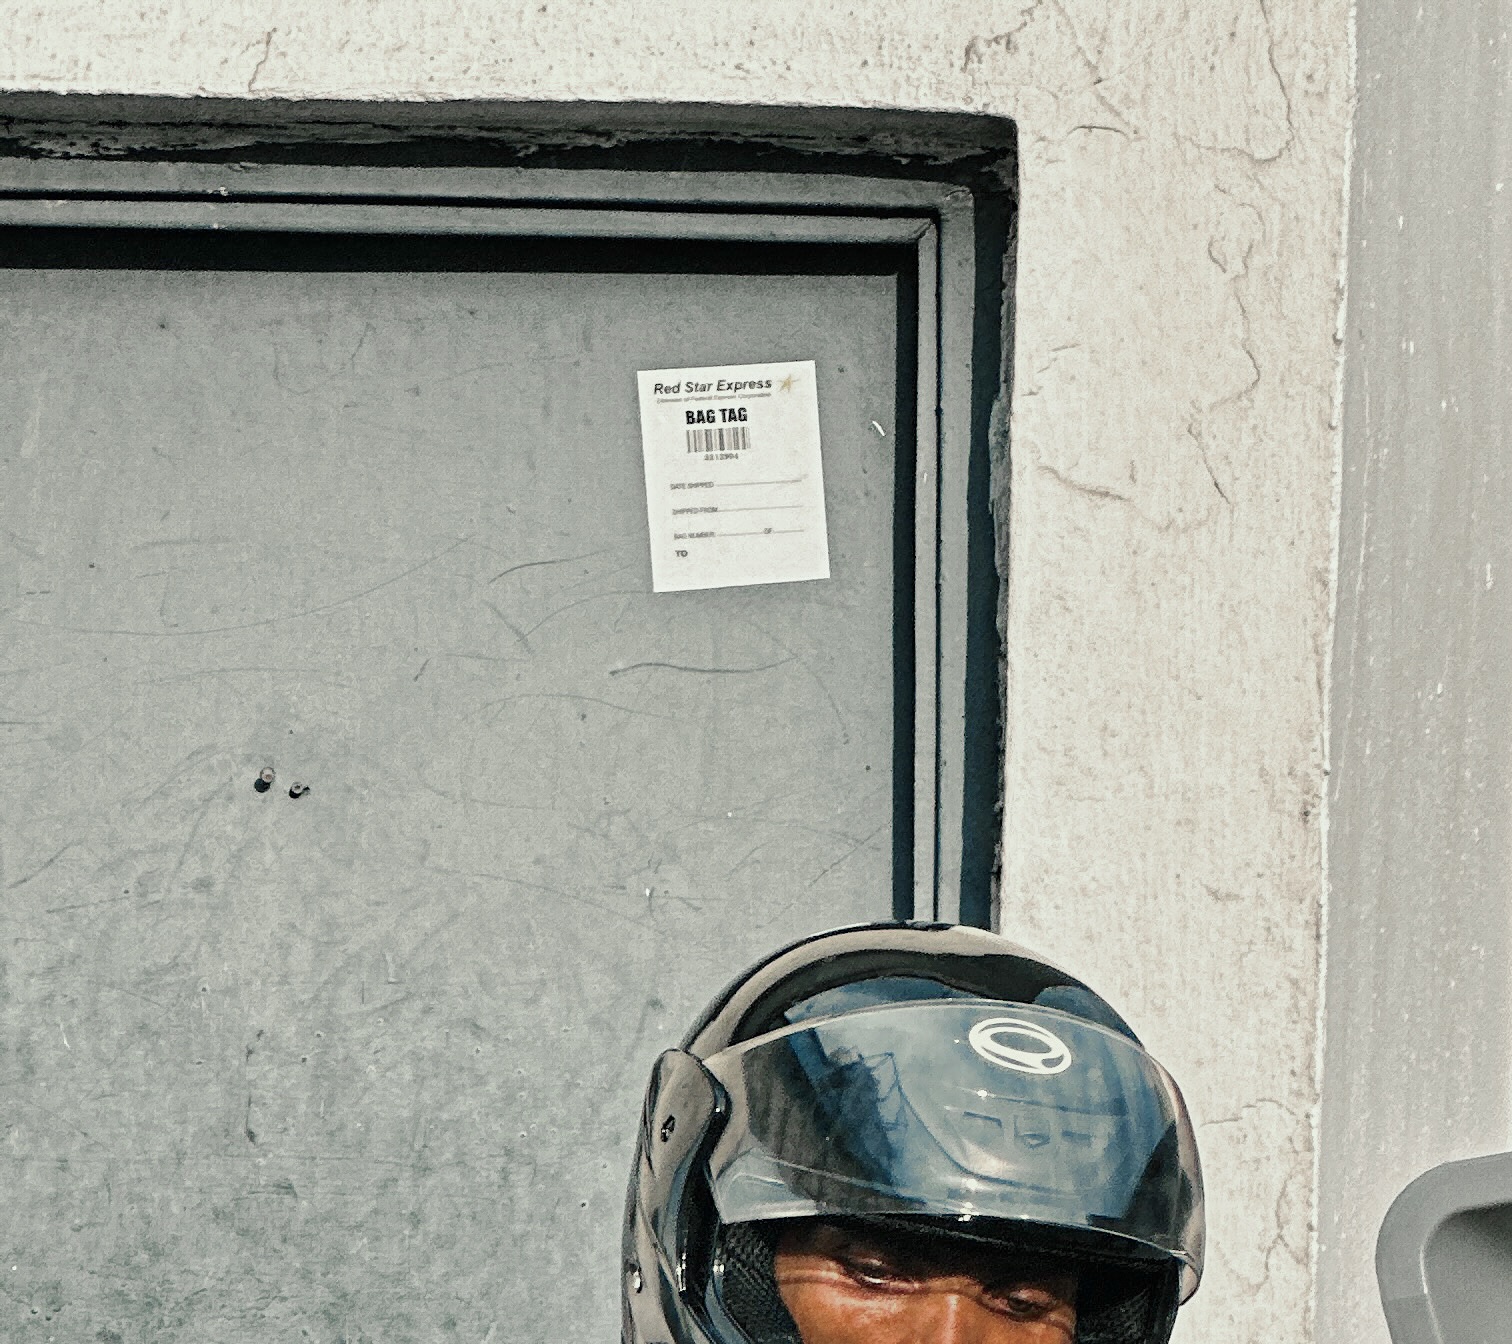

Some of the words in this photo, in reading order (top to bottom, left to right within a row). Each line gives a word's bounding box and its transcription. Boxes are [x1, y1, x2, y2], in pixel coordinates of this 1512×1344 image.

[654, 380, 680, 395] Red
[685, 380, 713, 393] Star
[716, 378, 773, 393] Express
[685, 409, 716, 425] BAG
[719, 407, 748, 423] TAG
[675, 549, 688, 558] TO
